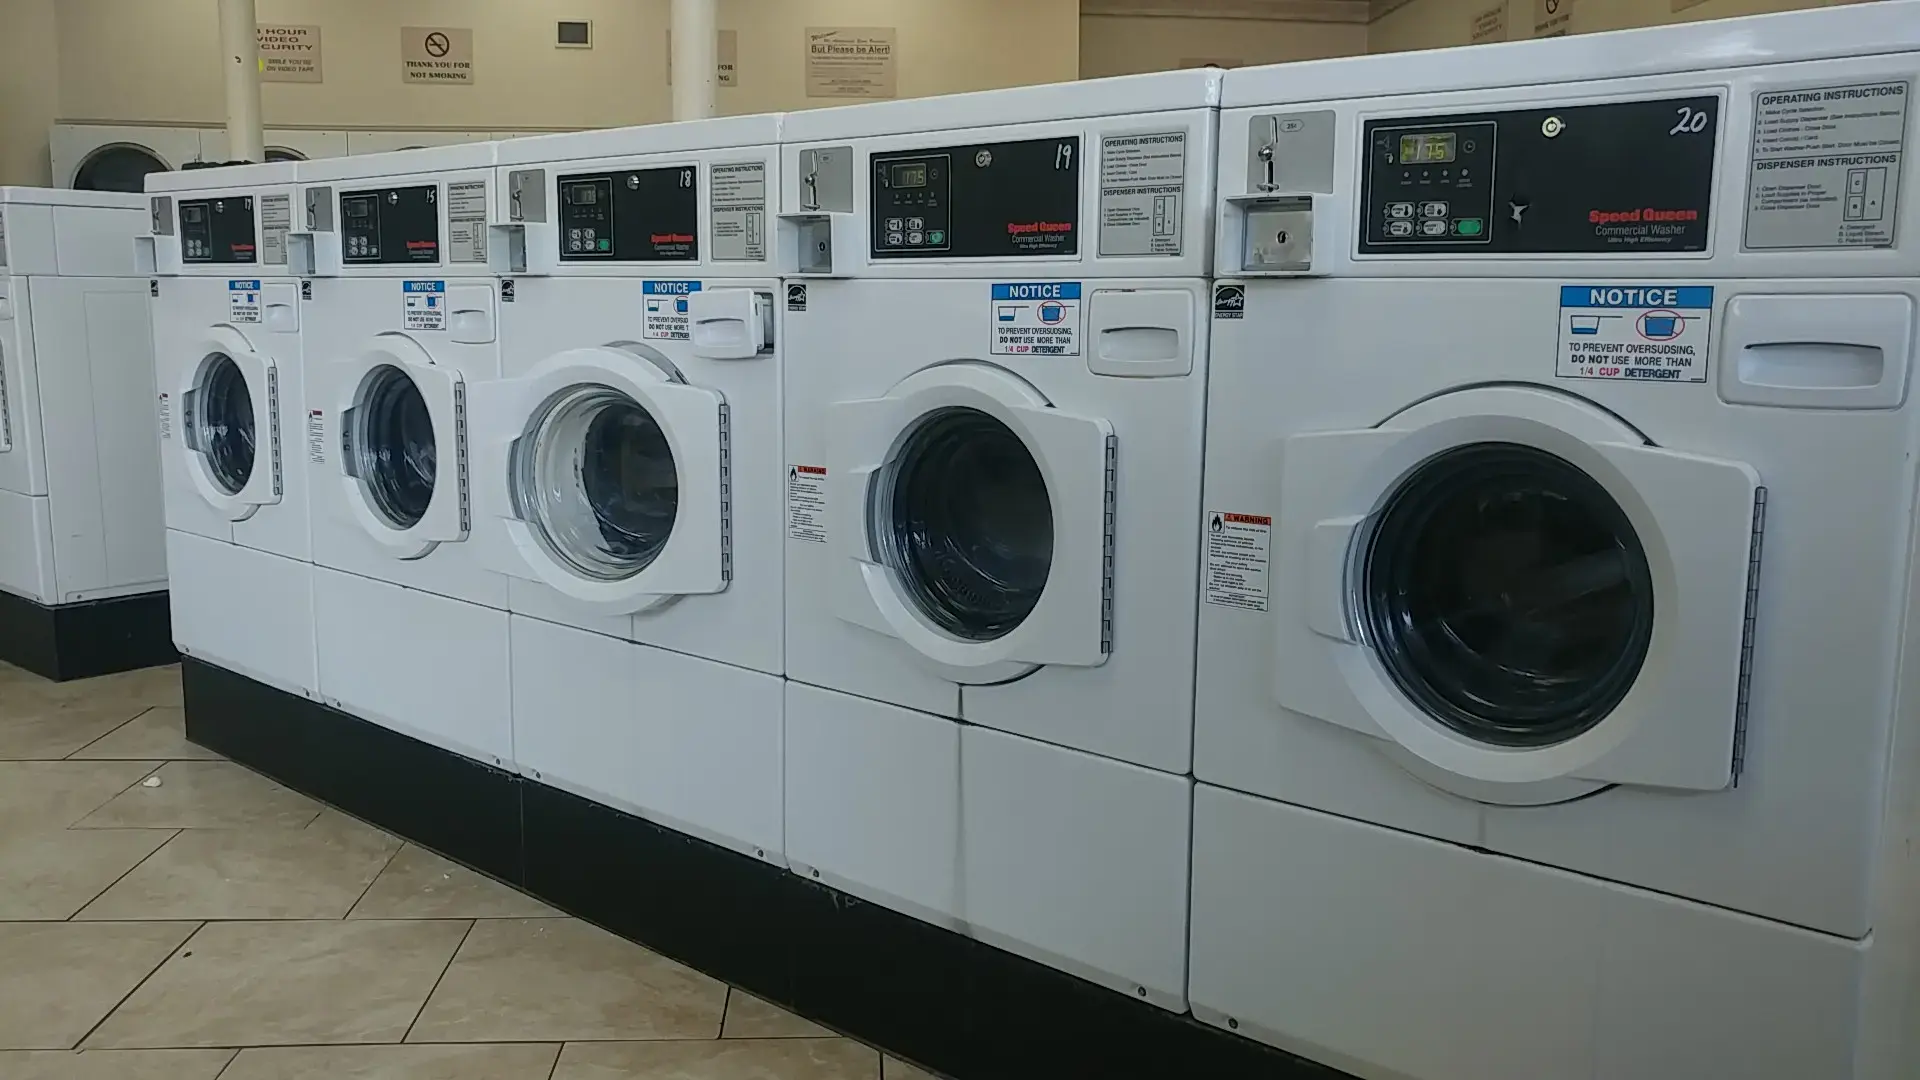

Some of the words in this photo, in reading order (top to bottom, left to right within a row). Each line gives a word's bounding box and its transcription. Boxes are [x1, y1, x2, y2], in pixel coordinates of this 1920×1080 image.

[828, 45, 854, 54] Please
[1762, 92, 1821, 106] OPERATING
[1824, 86, 1904, 101] INSTRUCTIONS
[1669, 107, 1708, 136] 20
[1105, 139, 1138, 147] OPERATING
[1139, 135, 1183, 144] INSTRUCTIONS
[1056, 144, 1072, 170] 19
[1756, 161, 1815, 170] DISPENSER
[1817, 155, 1897, 166] INSTRUCTIONS
[680, 170, 691, 187] 18
[426, 189, 435, 203] 15
[1104, 188, 1136, 196] DISPENSER
[1137, 186, 1181, 194] INSTRUCTIONS
[1589, 209, 1640, 225] Speed
[1643, 208, 1698, 220] Queen
[1008, 222, 1038, 235] Speed
[1040, 221, 1072, 231] Queen
[1595, 225, 1648, 236] Commercial
[1651, 224, 1685, 235] Washer
[1012, 234, 1043, 243] Commercial
[1045, 234, 1064, 242] Washer
[654, 283, 688, 293] NOTICE
[1009, 285, 1060, 298] NOTICE
[1590, 289, 1678, 306] NOTICE
[1032, 328, 1073, 336] OVERSUDSING,
[1569, 343, 1580, 352] TO
[1583, 343, 1624, 352] PREVENT
[1626, 344, 1696, 356] OVERSUDSING,
[1571, 355, 1585, 363] DO
[1588, 355, 1609, 364] NOT
[1612, 356, 1630, 365] USE
[1634, 357, 1662, 366] MORE
[1666, 358, 1692, 367] THAN
[1580, 367, 1594, 375] 1/4
[1599, 368, 1620, 376] CUP
[1625, 369, 1681, 379] DETERGENT
[1234, 516, 1268, 524] WARNING
